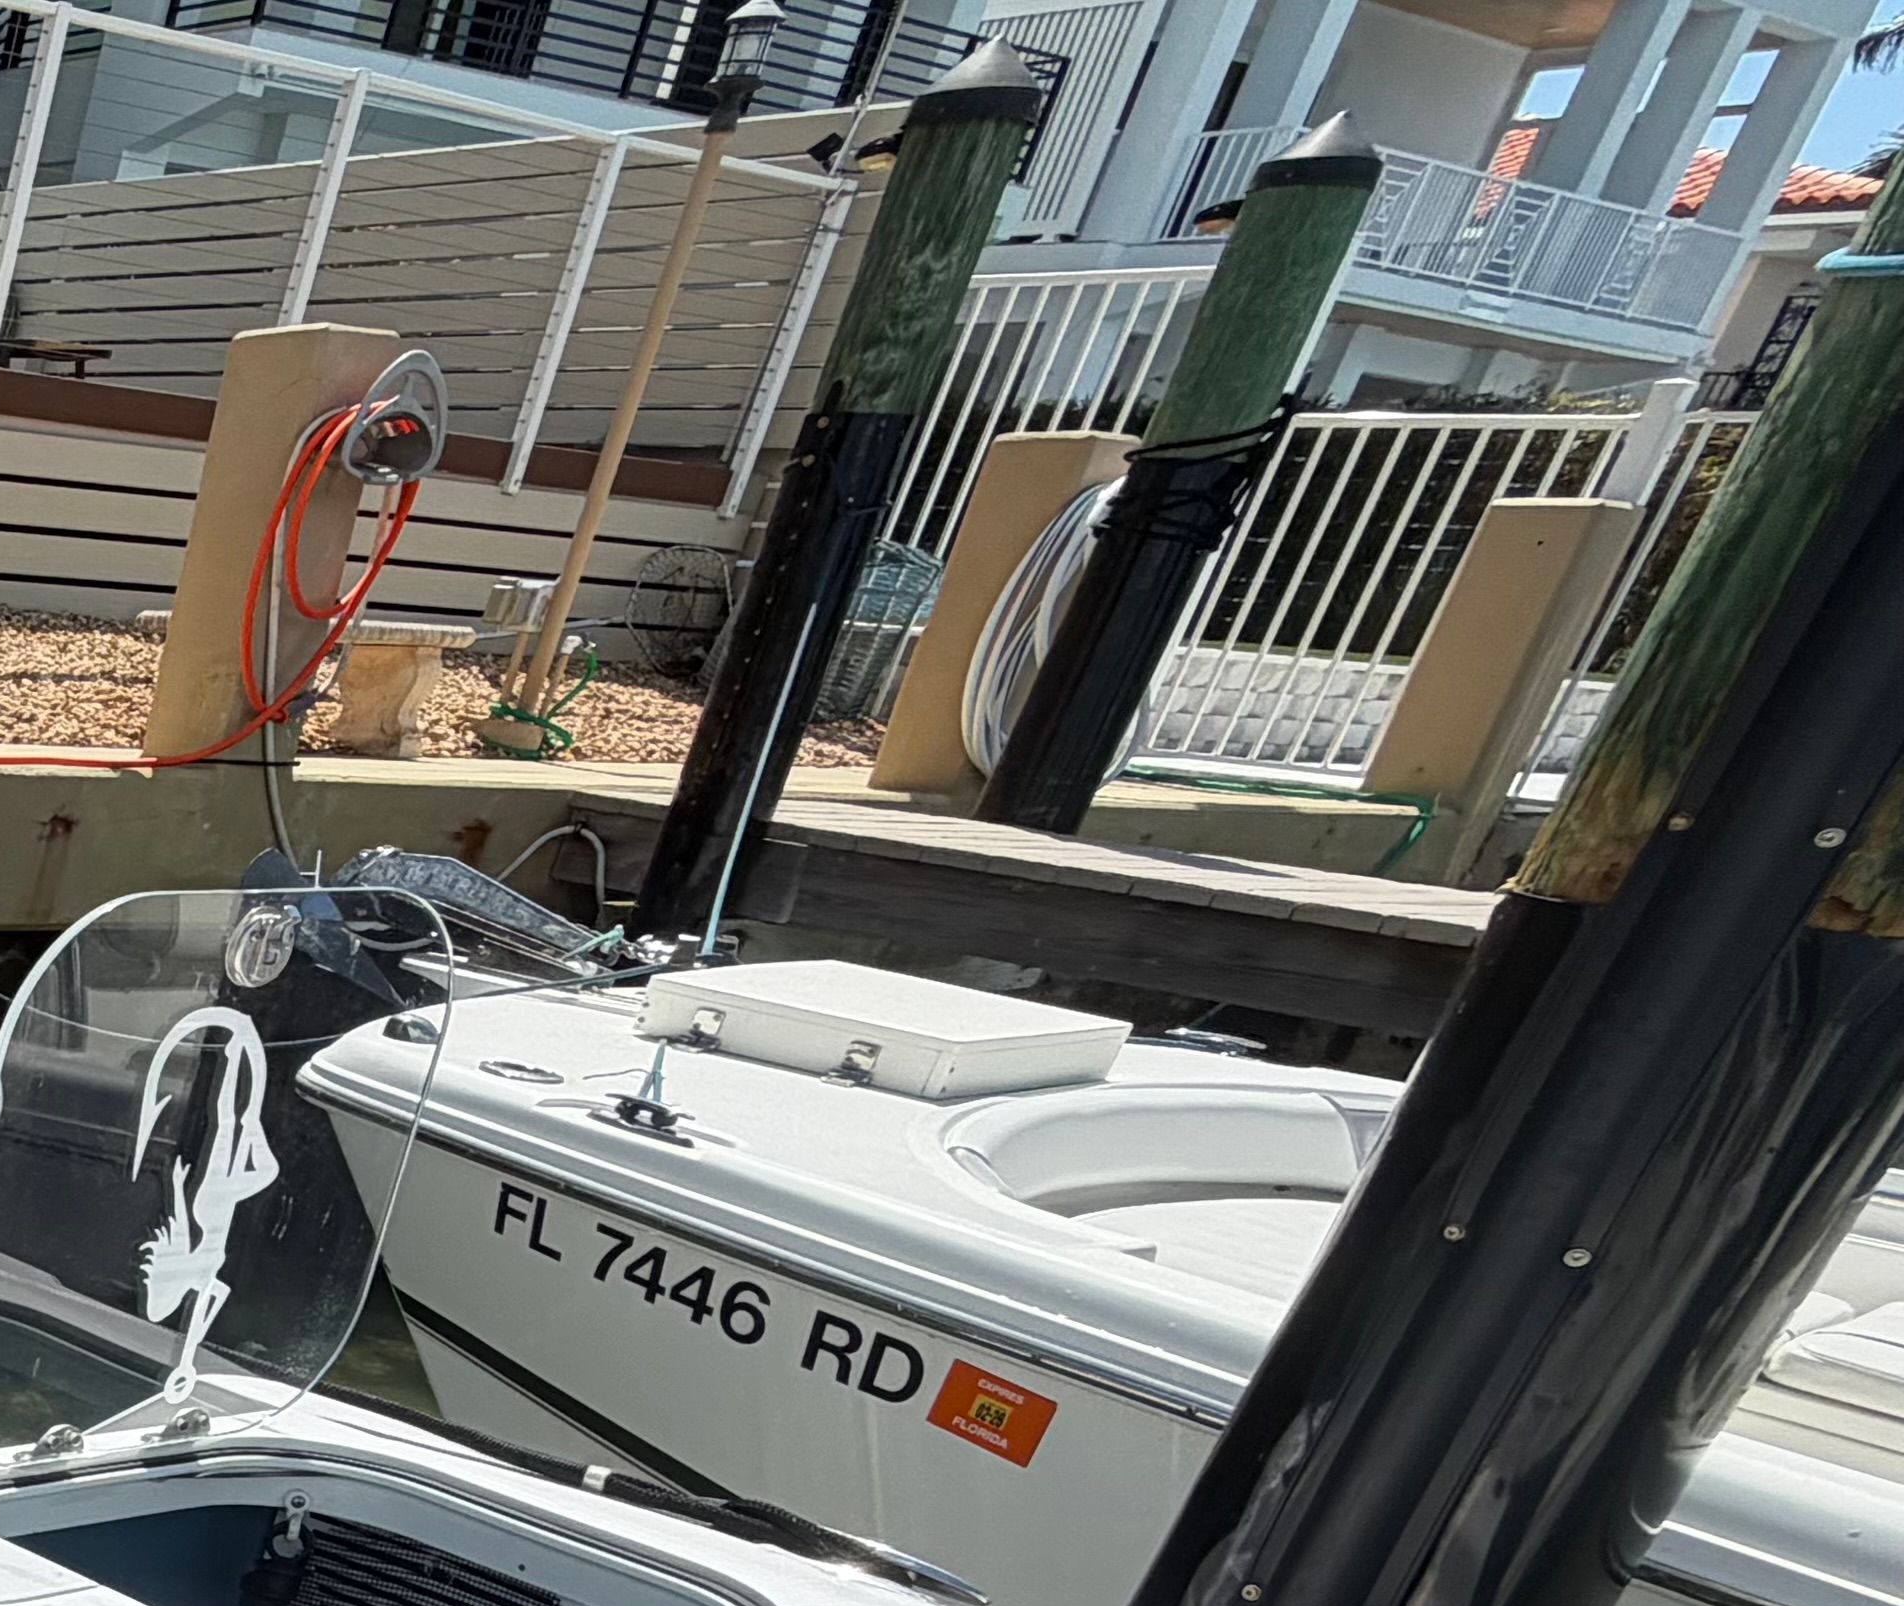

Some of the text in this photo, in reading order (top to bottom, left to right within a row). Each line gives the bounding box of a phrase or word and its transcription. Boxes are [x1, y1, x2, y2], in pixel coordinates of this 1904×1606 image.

[493, 1181, 925, 1403] FL 7446 RD
[977, 1378, 1024, 1405] EXPIRES
[952, 1415, 1008, 1449] FLORIDA
